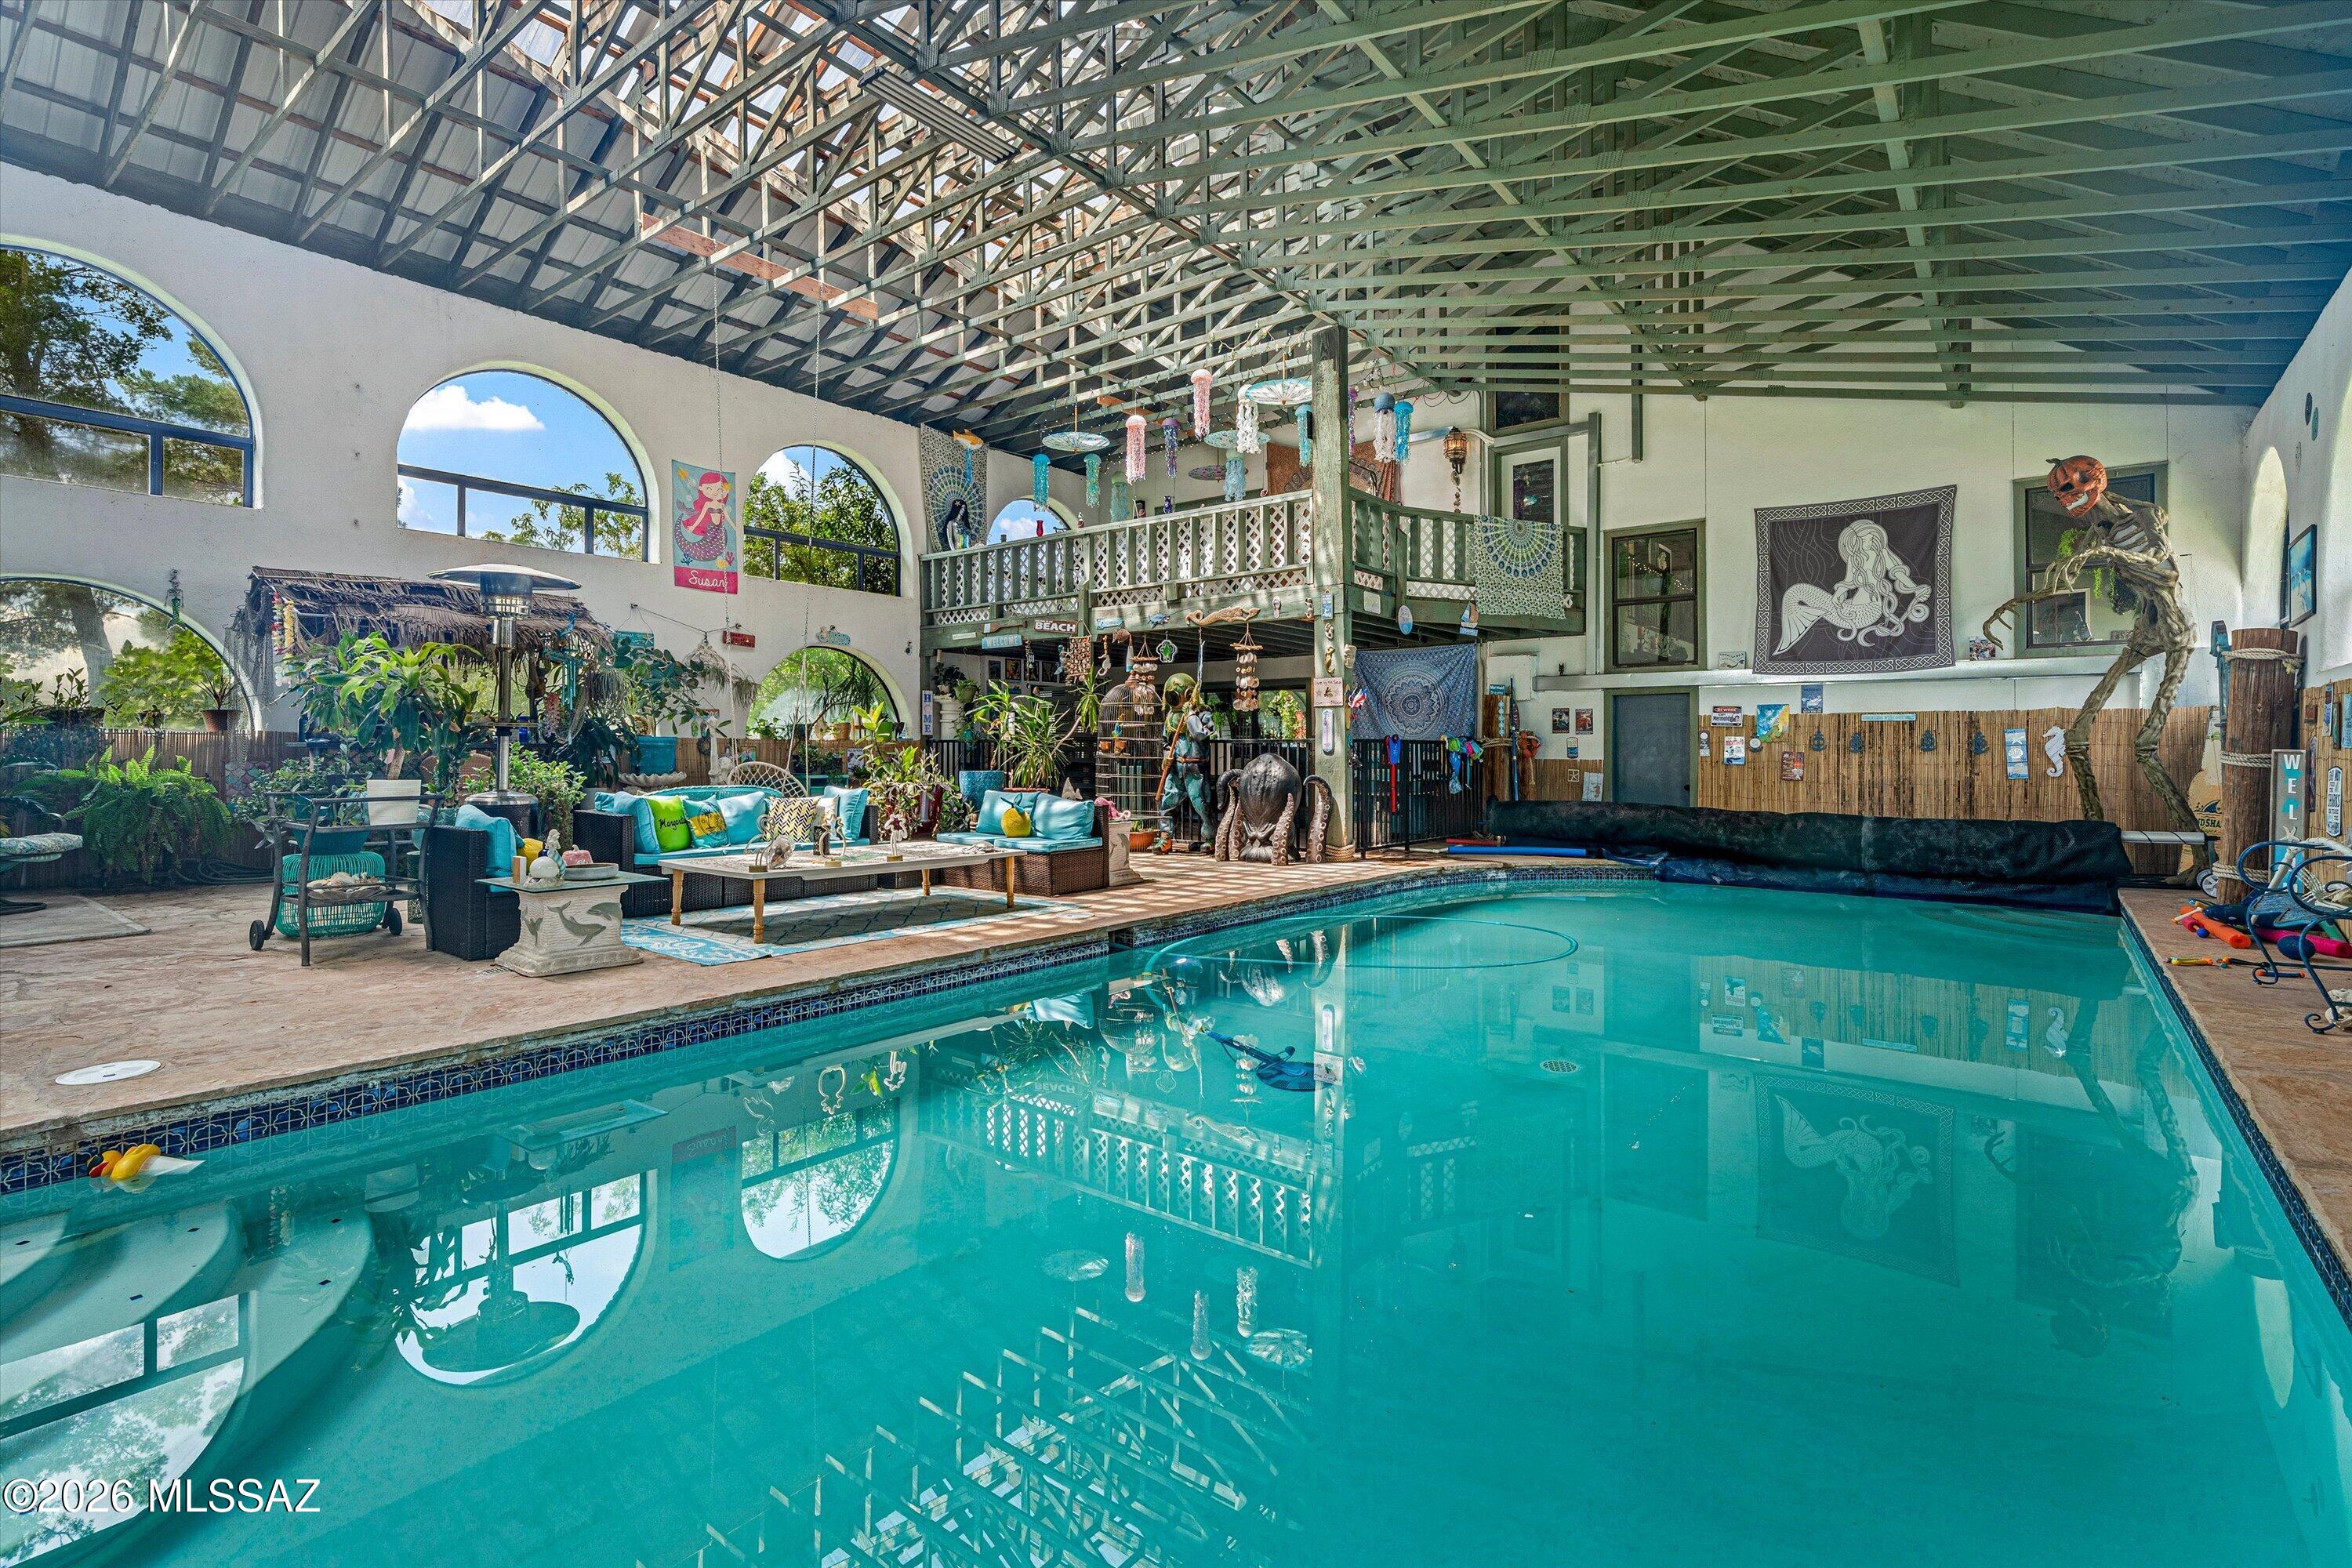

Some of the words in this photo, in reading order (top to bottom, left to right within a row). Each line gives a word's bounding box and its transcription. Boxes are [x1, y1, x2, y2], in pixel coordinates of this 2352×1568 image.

[688, 570, 728, 588] Susan
[1035, 622, 1076, 632] BEACH
[985, 635, 1018, 647] WELCOME
